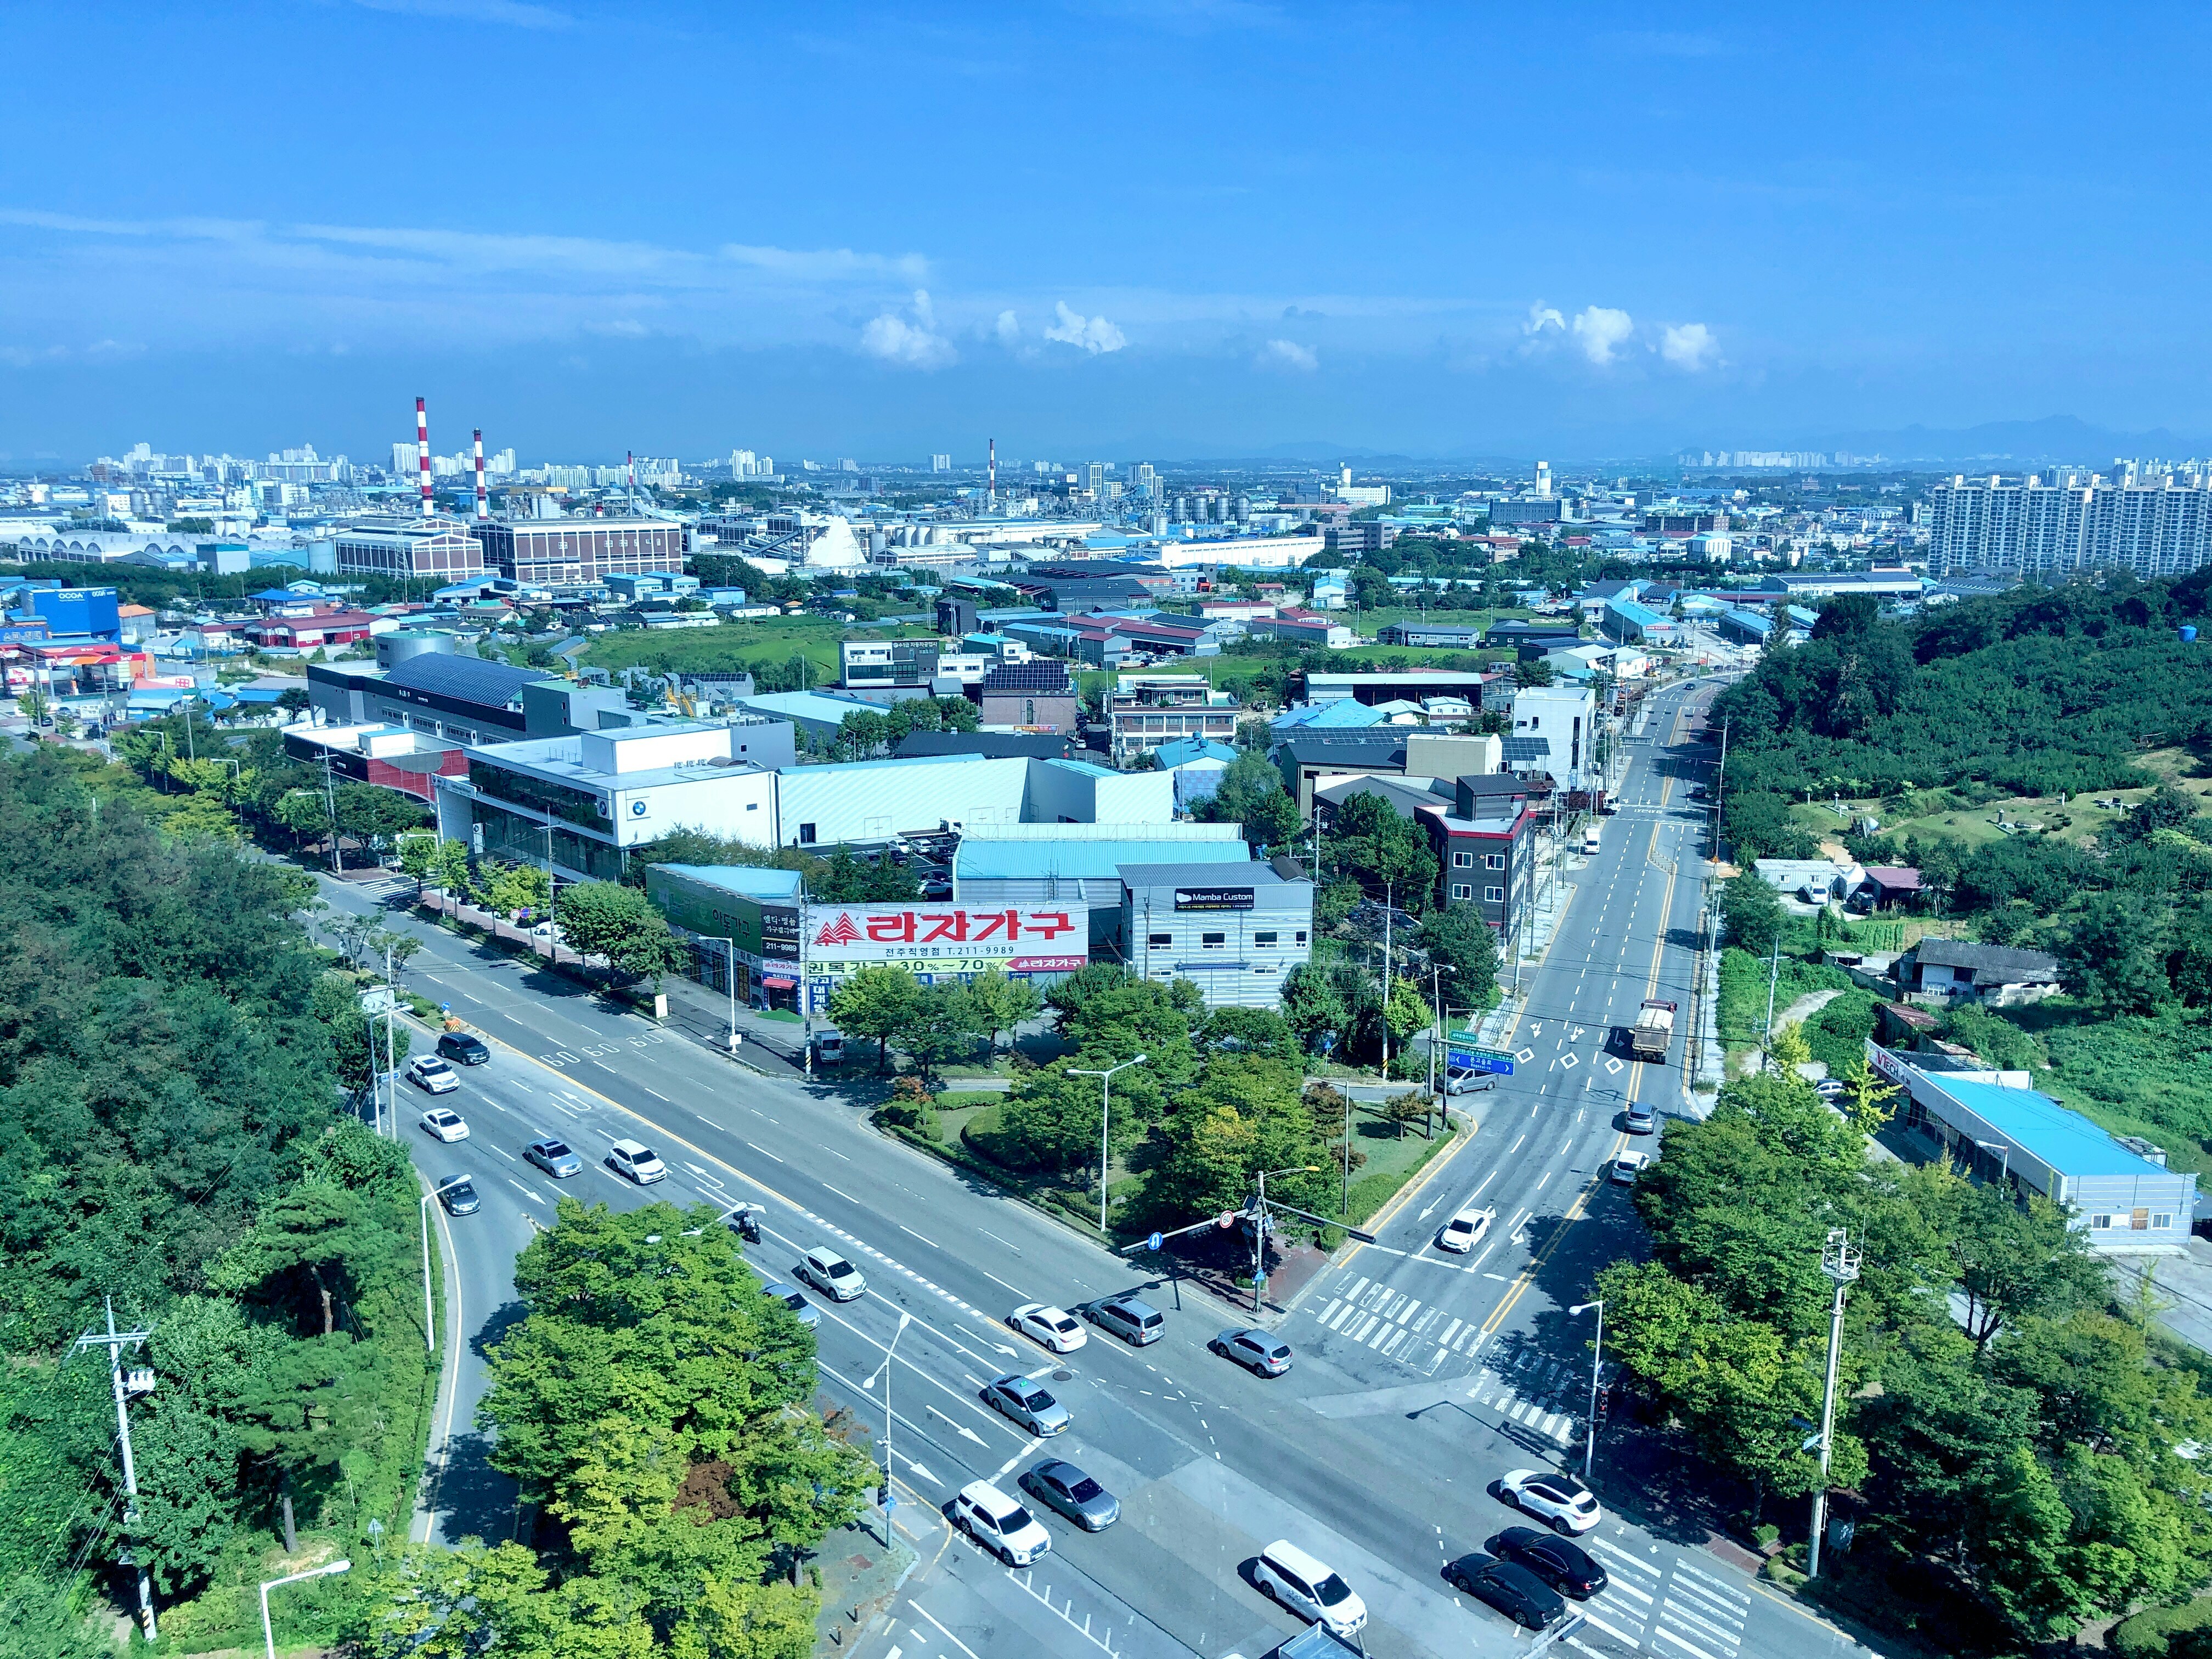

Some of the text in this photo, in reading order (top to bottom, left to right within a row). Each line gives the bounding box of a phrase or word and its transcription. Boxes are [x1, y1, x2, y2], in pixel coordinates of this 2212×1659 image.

[1223, 893, 1253, 901] Custom
[712, 908, 751, 939] 아동가구
[866, 909, 1075, 943] 라자가구
[766, 942, 797, 952] 211-9989
[885, 946, 940, 957] 전주직영점
[1030, 958, 1081, 968] 라자가구
[625, 1034, 664, 1047] 60
[1452, 1032, 1475, 1041] 서곡광장사거리
[581, 1043, 620, 1057] 60
[539, 1051, 582, 1067] 60
[1470, 1057, 1492, 1065] 온고을로
[1223, 1215, 1230, 1223] 60
